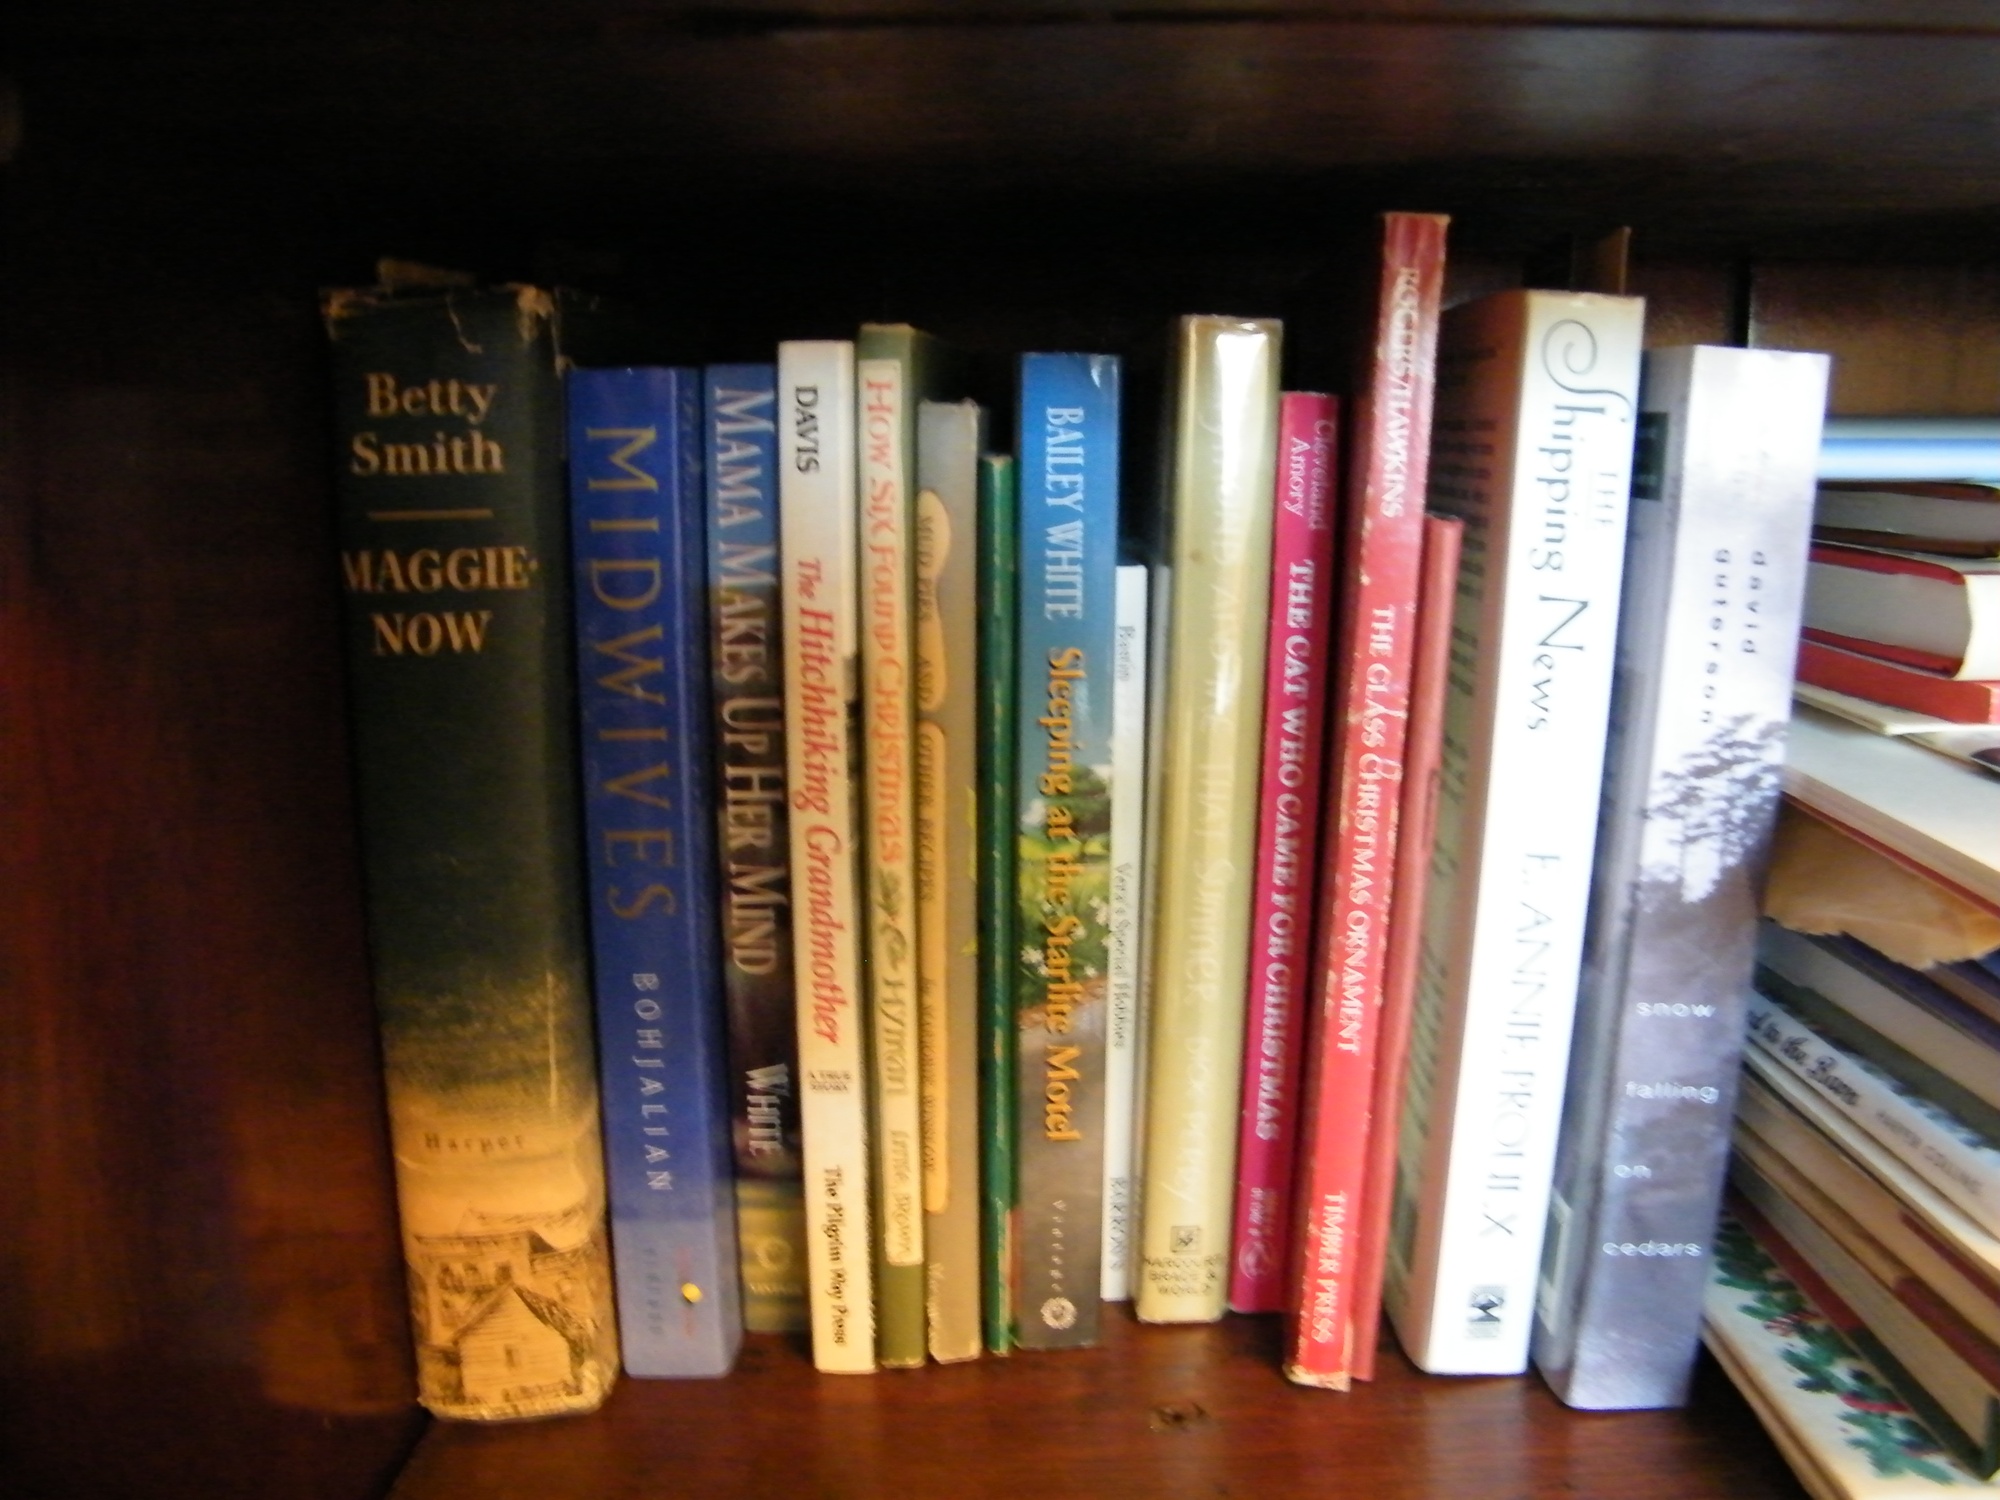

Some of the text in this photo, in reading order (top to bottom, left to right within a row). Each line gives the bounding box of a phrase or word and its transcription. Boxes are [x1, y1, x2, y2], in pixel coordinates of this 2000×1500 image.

[366, 372, 498, 424] Betty
[795, 385, 820, 475] DAVIS
[350, 429, 505, 477] Smith
[1283, 438, 1312, 517] Amory
[1308, 419, 1337, 531] Cleveland
[1044, 406, 1084, 622] BAILEY WHITE
[1525, 317, 1633, 732] Shipping News
[370, 610, 493, 657] NOW
[1368, 603, 1395, 658] THE
[1742, 549, 1768, 655] david
[586, 425, 677, 920] MIDWIVES
[714, 386, 788, 976] MAMA MAKES UP HER MIND
[794, 556, 849, 1047] The Hitchhiking Grandmother
[1256, 558, 1315, 1142] THE CAT WHO CAME FOR CHRISTMAS
[1348, 752, 1403, 906] CHRISTMAS
[1037, 647, 1087, 1144] Sleeping at the Starlite Motel
[1336, 909, 1371, 1056] ORNAMENT
[1636, 1000, 1716, 1018] snow
[632, 972, 674, 1191] BOHJALIAN
[745, 1063, 790, 1156] WHITE
[1625, 1079, 1720, 1105] falling
[823, 1165, 842, 1198] The
[1614, 1162, 1652, 1180] on
[824, 1200, 847, 1265] Pilgrim
[1310, 1190, 1348, 1344] TIMBER PRESS
[1602, 1237, 1702, 1258] cedars
